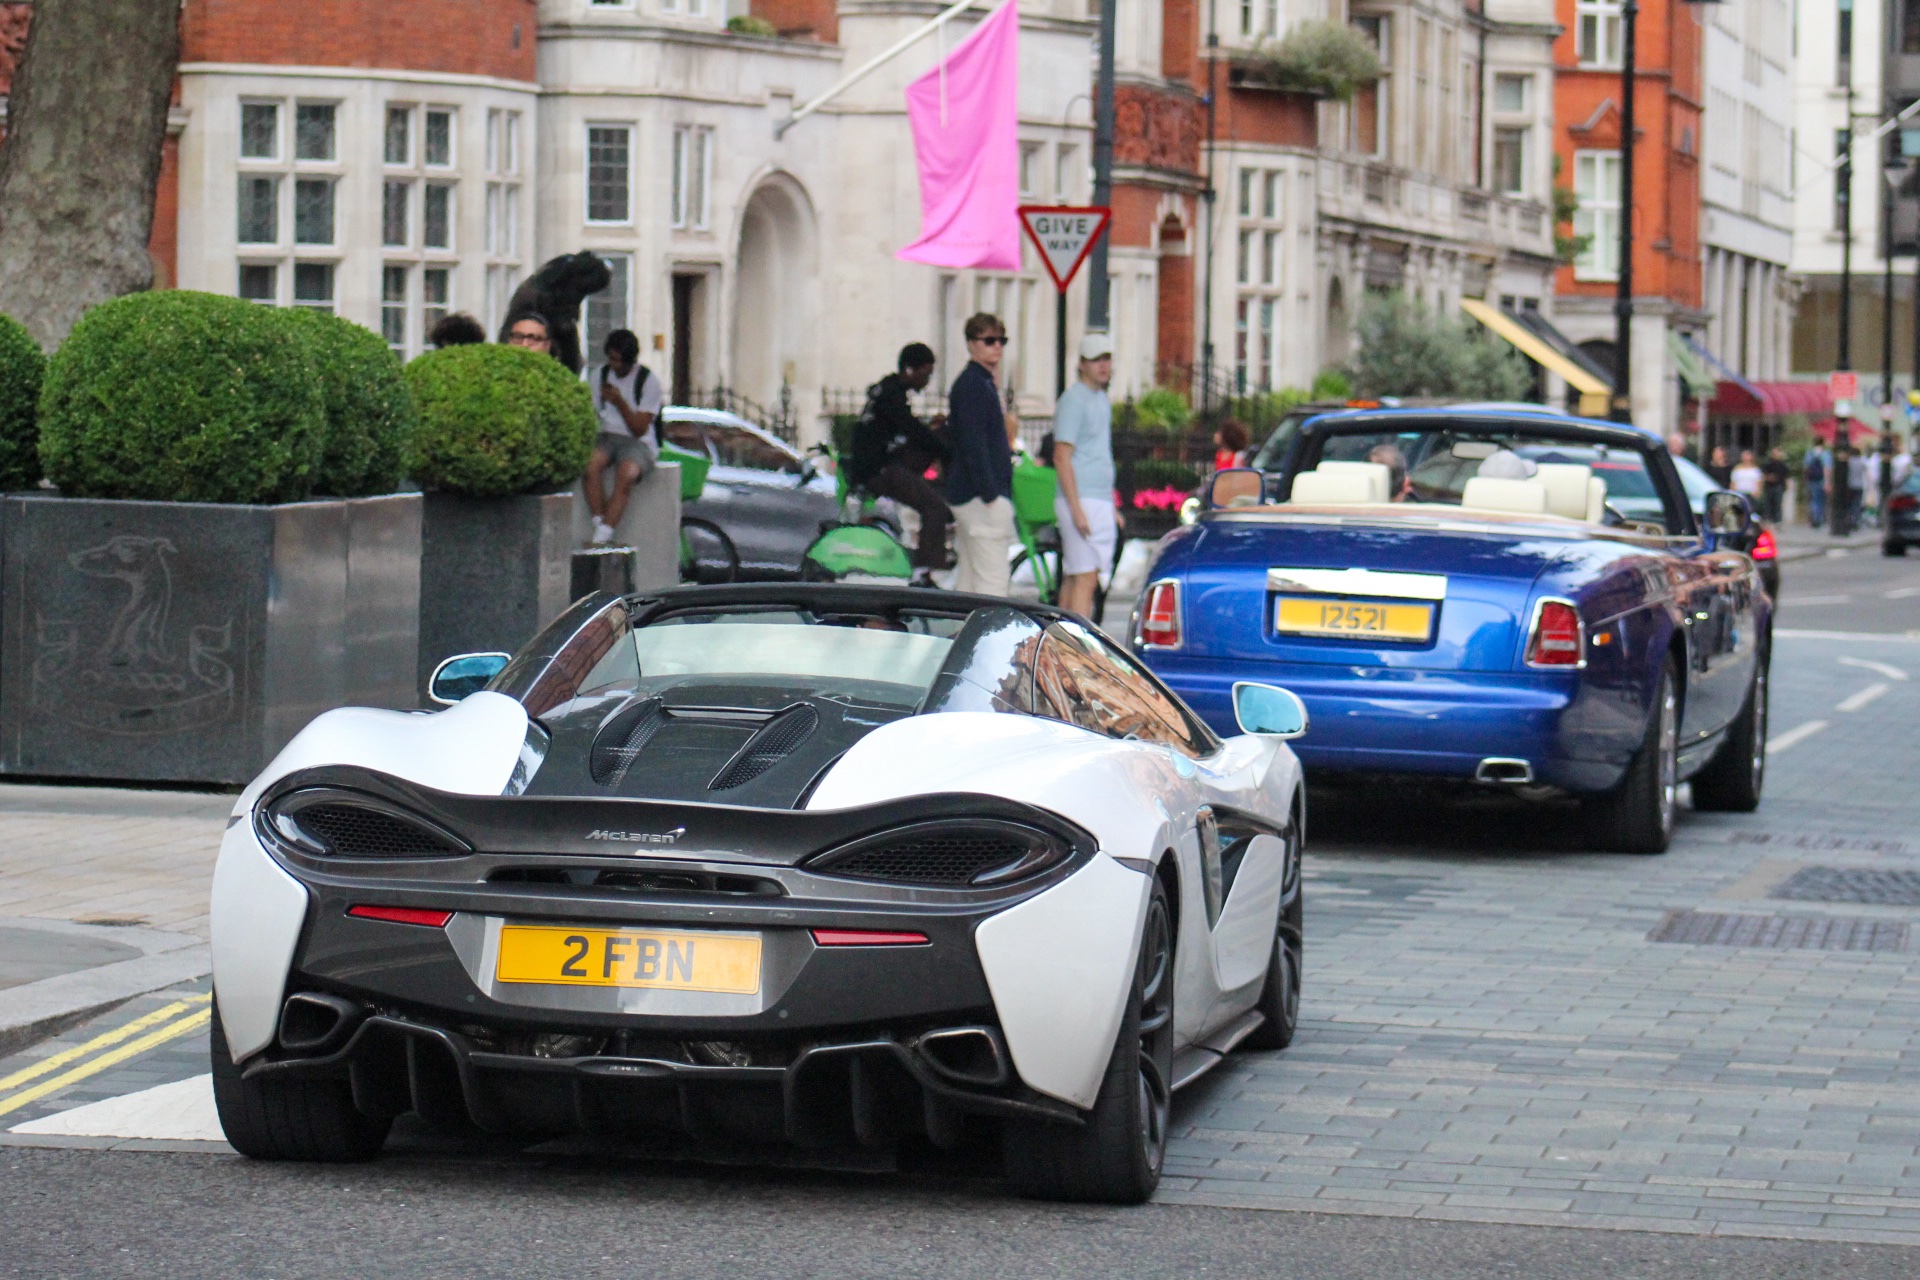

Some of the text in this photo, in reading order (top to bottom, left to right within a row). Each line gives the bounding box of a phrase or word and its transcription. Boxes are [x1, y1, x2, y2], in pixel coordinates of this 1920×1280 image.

[1035, 217, 1088, 235] GIVE
[1047, 240, 1079, 250] WAY
[1320, 605, 1387, 631] 12521
[585, 828, 677, 844] McLaren
[561, 935, 695, 983] 2 FBN
